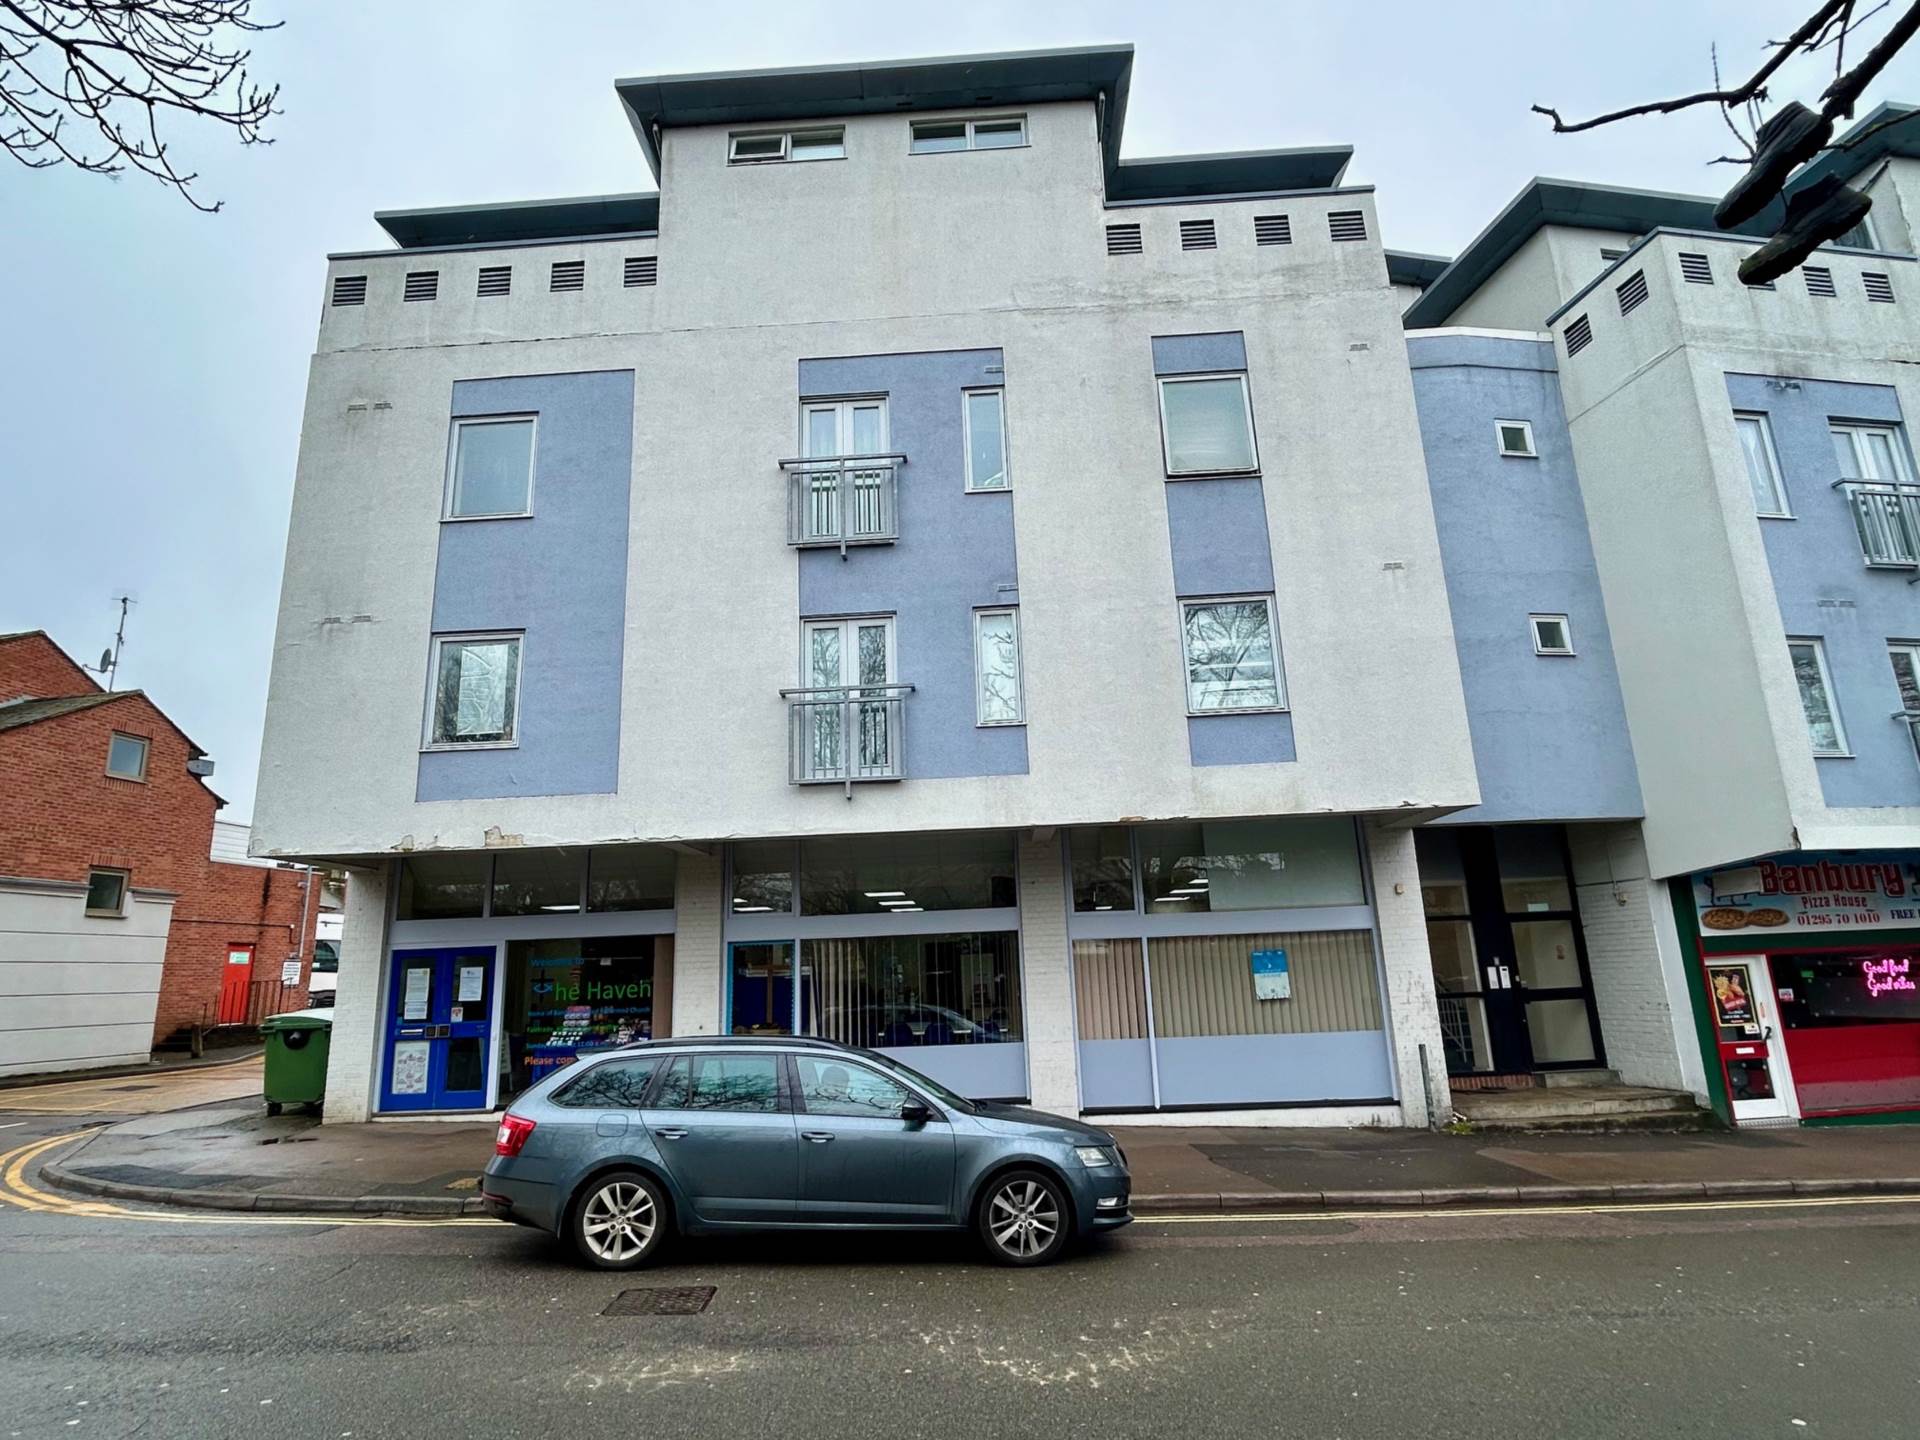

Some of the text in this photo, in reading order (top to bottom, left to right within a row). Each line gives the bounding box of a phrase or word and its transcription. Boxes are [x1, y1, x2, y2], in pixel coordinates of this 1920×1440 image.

[1758, 860, 1905, 897] Banbury
[1802, 894, 1868, 909] Pizza House
[1797, 912, 1881, 926] 01295 70 1010
[1890, 909, 1915, 920] FREE
[1863, 959, 1909, 979] Good food
[587, 980, 652, 1000] Haven
[1867, 977, 1893, 997] Good
[523, 1055, 554, 1066] Please
